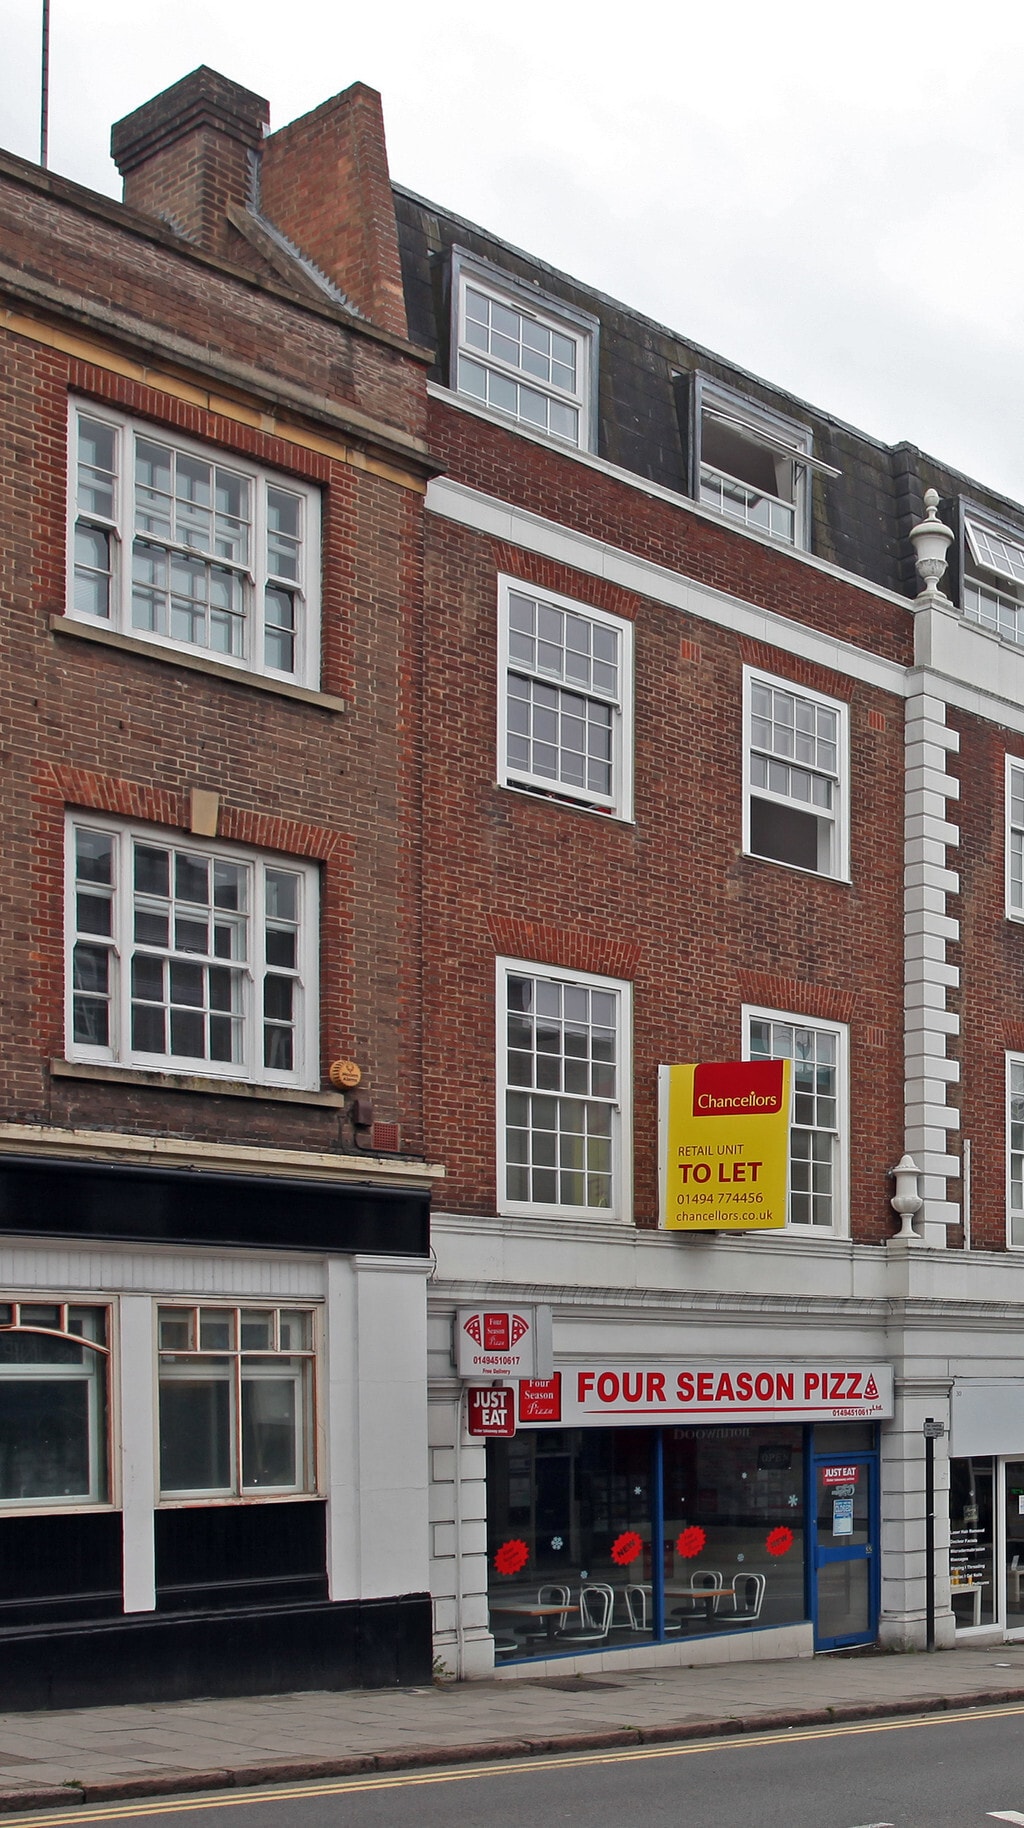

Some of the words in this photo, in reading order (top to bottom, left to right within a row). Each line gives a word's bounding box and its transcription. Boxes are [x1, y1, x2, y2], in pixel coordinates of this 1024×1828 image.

[698, 1091, 777, 1109] Chancellors
[678, 1146, 714, 1156] RETAIL
[717, 1144, 745, 1155] UNIT
[678, 1163, 712, 1184] TO
[718, 1162, 763, 1183] LET
[677, 1194, 714, 1205] 01494
[718, 1192, 764, 1204] 774456
[676, 1210, 773, 1222] chancellors.co.uk
[489, 1318, 502, 1326] Four
[487, 1326, 505, 1335] Season
[473, 1356, 520, 1365] 01494510617
[529, 1379, 551, 1388] Four
[577, 1372, 667, 1402] FOUR
[676, 1372, 794, 1401] SEASON
[473, 1391, 507, 1408] JUST
[524, 1390, 554, 1400] Season
[527, 1401, 554, 1415] Pizza
[482, 1409, 508, 1426] EAT
[824, 1467, 842, 1478] JUST
[842, 1466, 857, 1477] EAT
[771, 1534, 788, 1548] NEW
[617, 1540, 636, 1558] NEW
